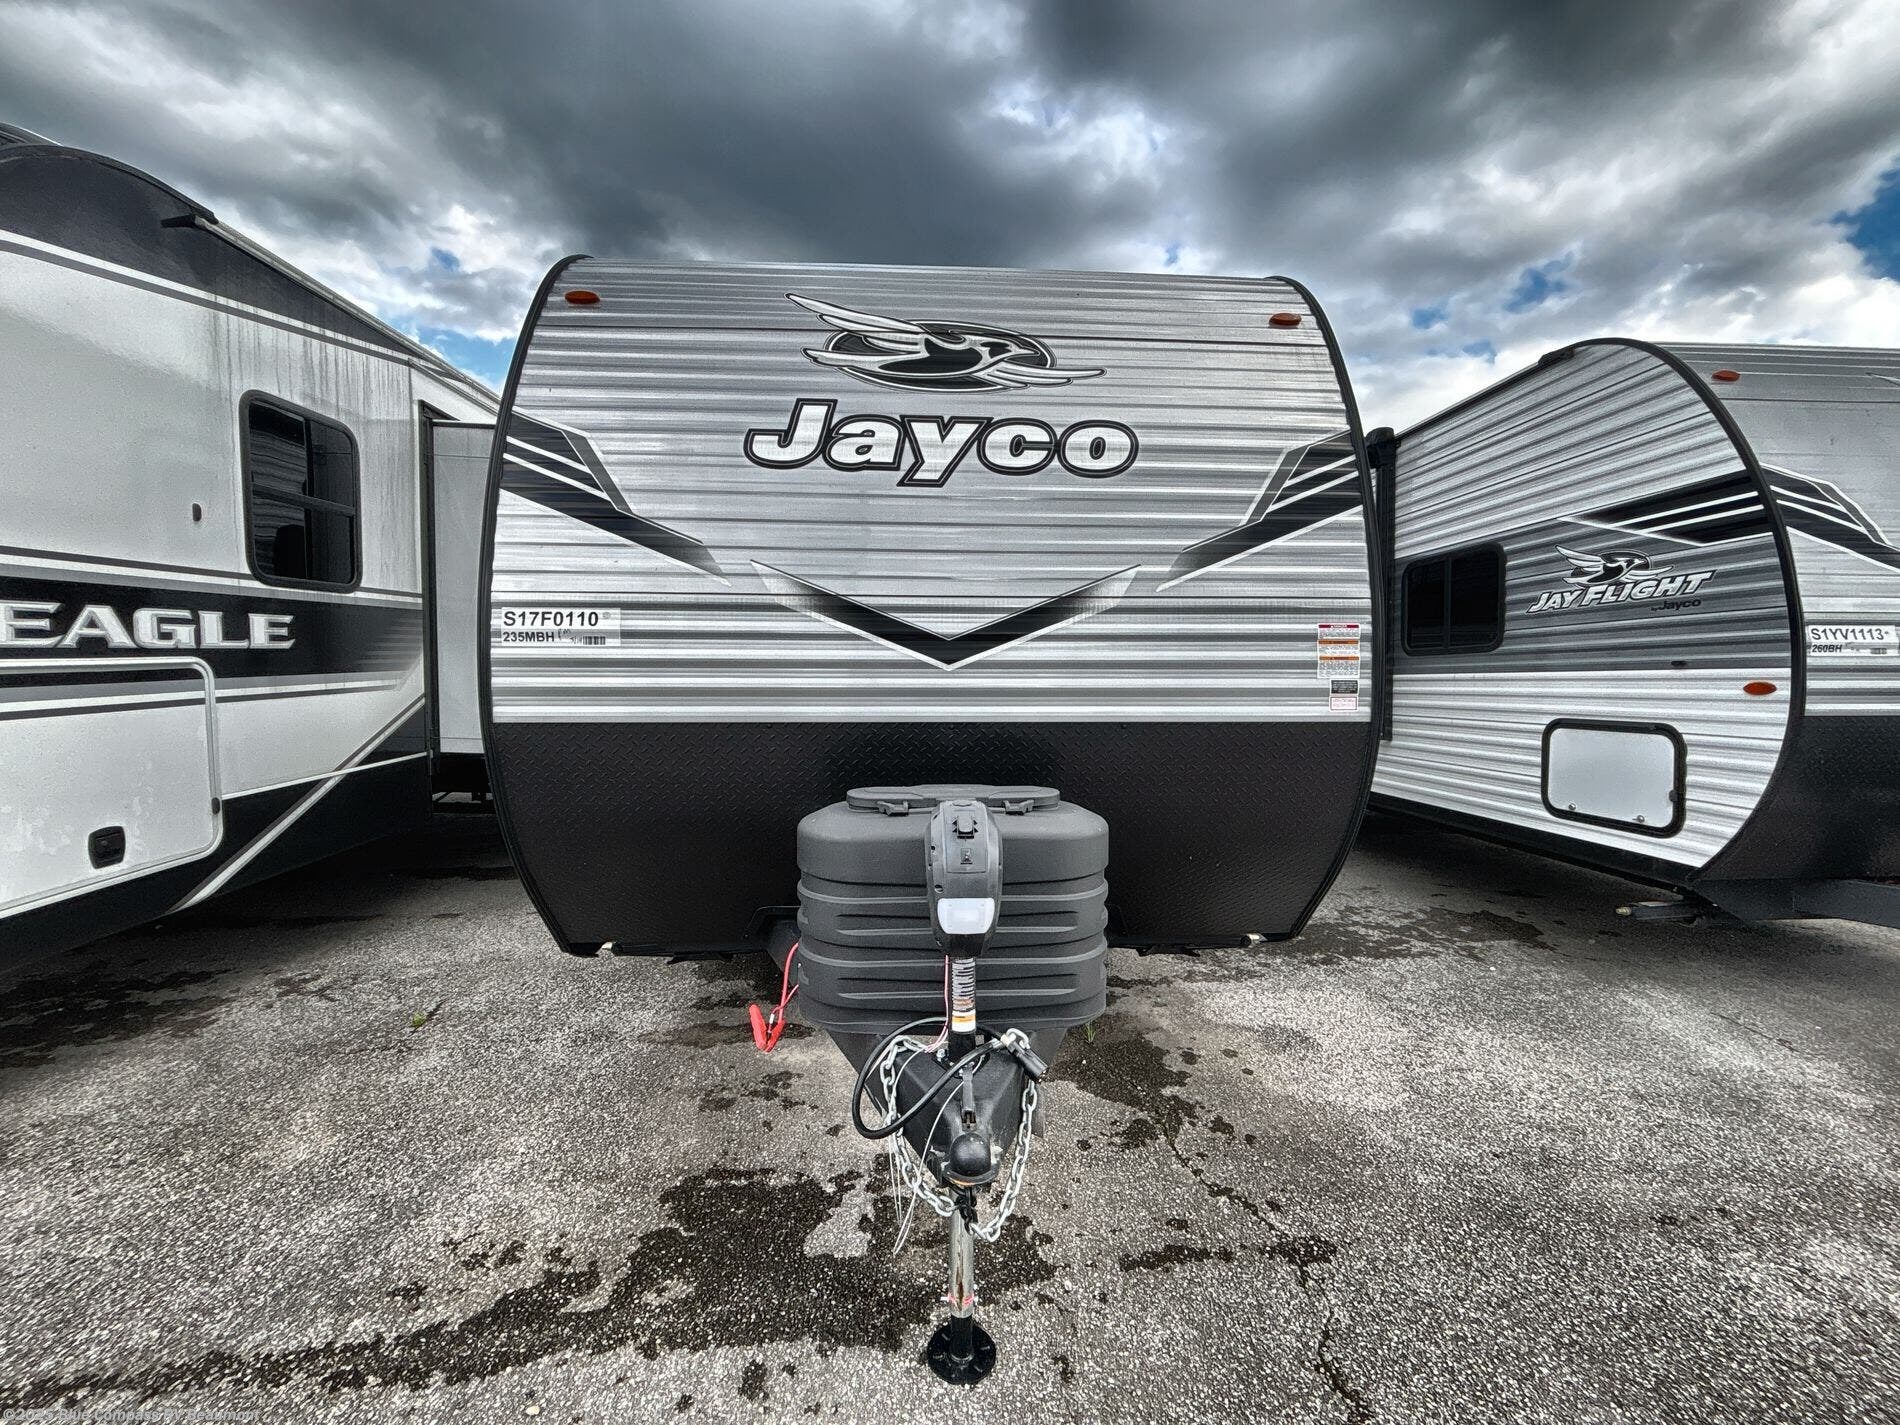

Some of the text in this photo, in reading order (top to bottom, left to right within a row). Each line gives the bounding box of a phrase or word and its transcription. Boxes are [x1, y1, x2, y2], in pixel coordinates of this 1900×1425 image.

[744, 398, 1139, 487] Jayco
[1526, 570, 1717, 613] JAY FLIGHT
[1658, 599, 1701, 611] Jayco
[0, 600, 296, 649] EAGLE
[503, 611, 599, 627] S17F0110
[502, 631, 555, 642] 235MBH
[1810, 628, 1884, 640] S1YV1113
[1811, 644, 1842, 653] 260BH
